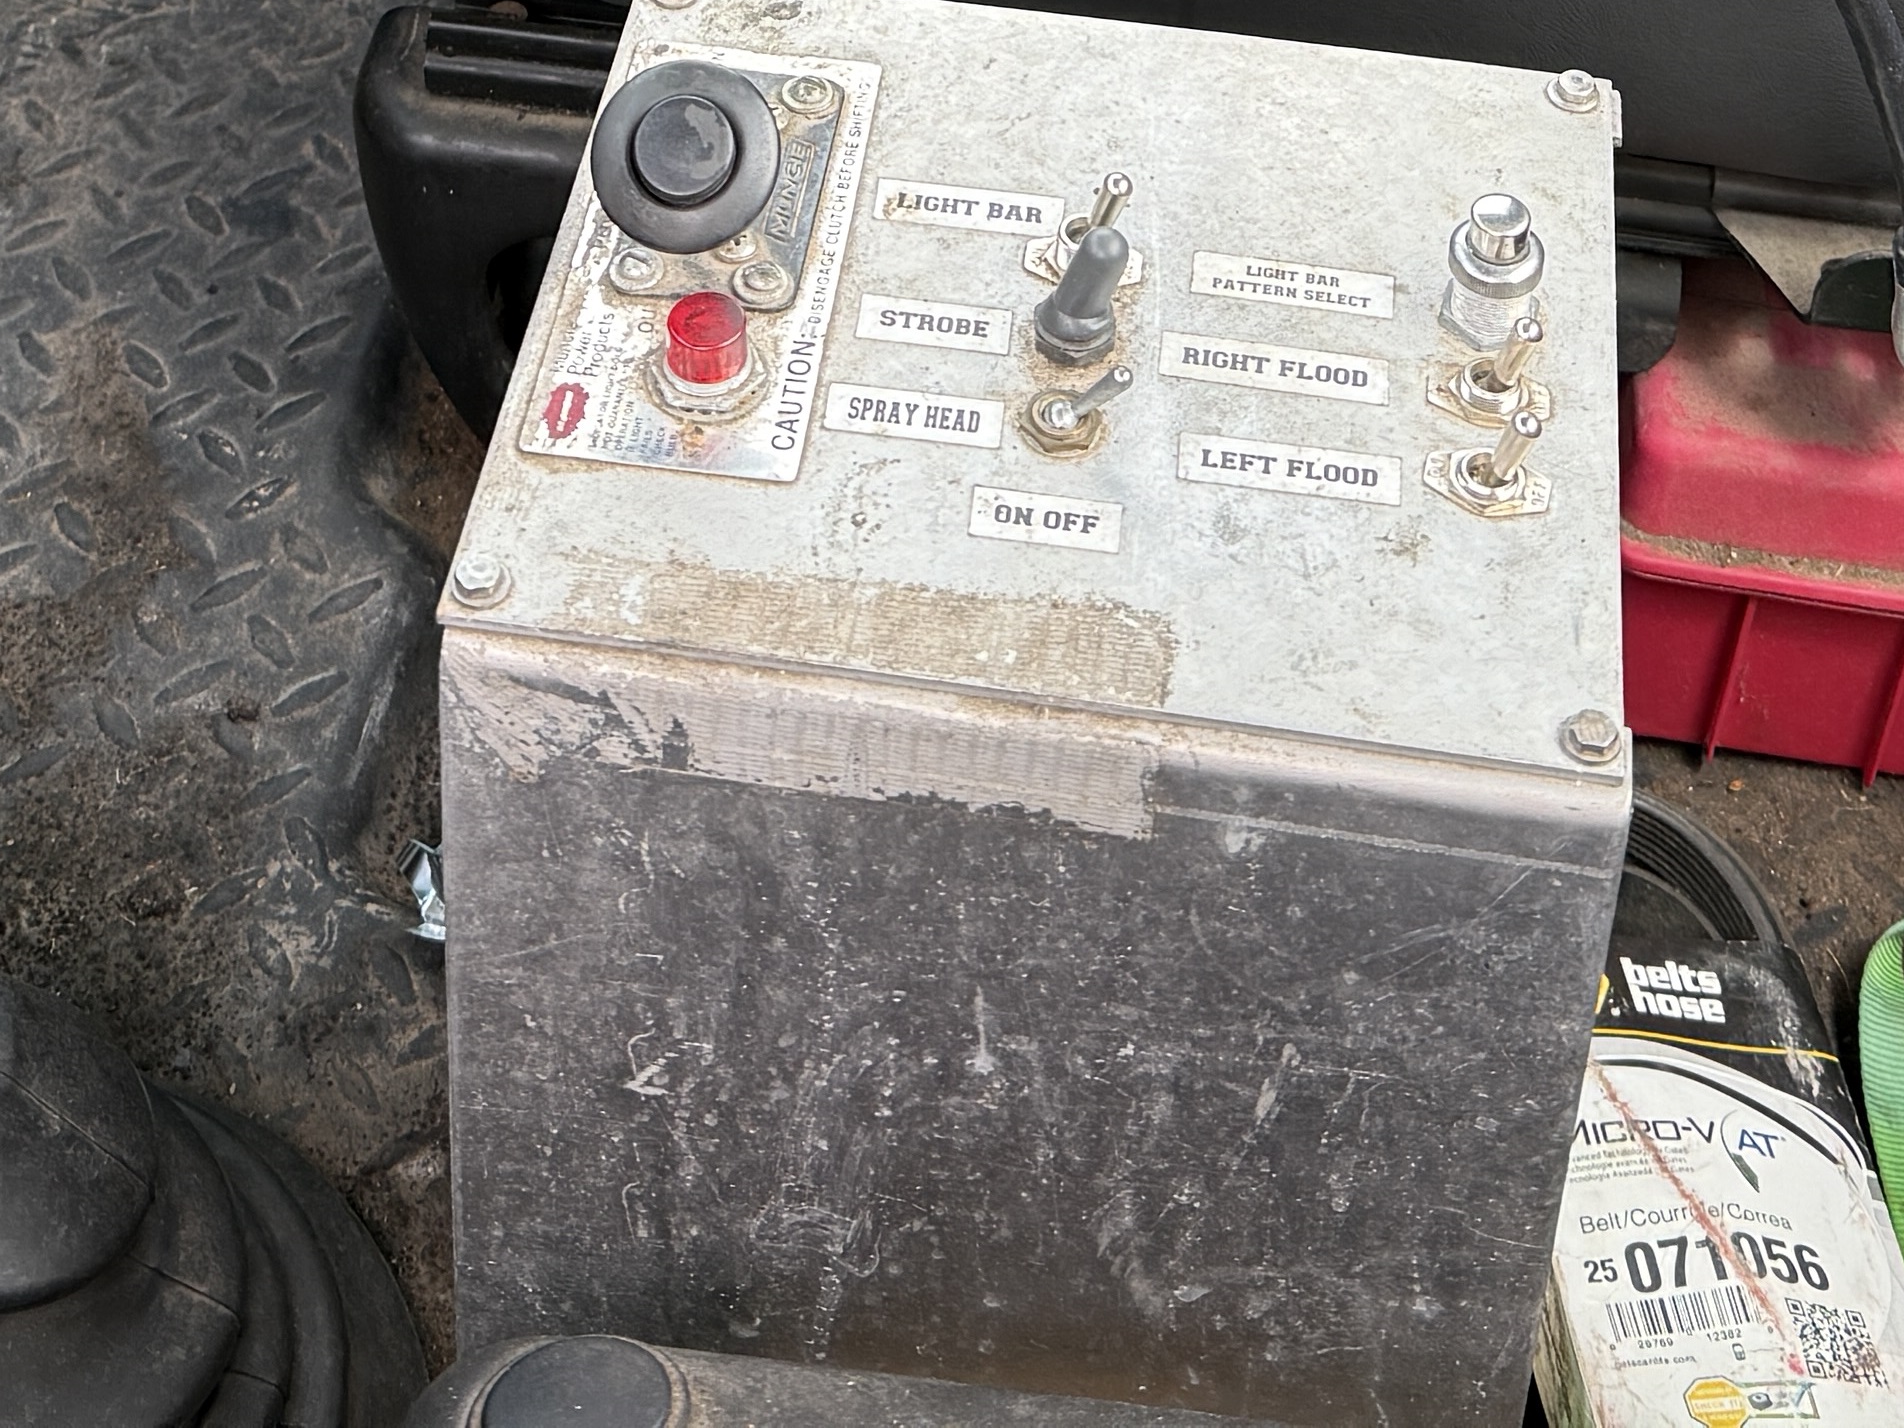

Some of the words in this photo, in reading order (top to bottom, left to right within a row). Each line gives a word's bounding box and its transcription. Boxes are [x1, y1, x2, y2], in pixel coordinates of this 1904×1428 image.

[895, 191, 980, 217] LIGHT
[986, 202, 1042, 225] BAR
[807, 245, 836, 326] DISENGAGE
[826, 190, 847, 245] CLUTCH
[837, 139, 860, 191] BEFORE
[1212, 276, 1299, 299] PATTERN
[1303, 289, 1372, 309] SELECT
[1245, 265, 1299, 283] LIGHT
[1305, 273, 1340, 288] BAR
[879, 309, 991, 339] STROBE
[583, 312, 615, 377] Products
[1181, 346, 1271, 375] RIGHT
[1278, 359, 1369, 388] FLOOD
[847, 396, 920, 427] SPRAY
[924, 404, 981, 434] HEAD
[1200, 448, 1278, 475] LEFT
[1286, 459, 1379, 487] FLOOD
[994, 503, 1035, 527] ON
[1042, 510, 1101, 535] OFF
[1619, 956, 1723, 995] belts
[1631, 986, 1727, 1024] hose
[1738, 1128, 1779, 1159] AT
[1583, 1257, 1619, 1284] 25
[1624, 1231, 1830, 1293] 071056
